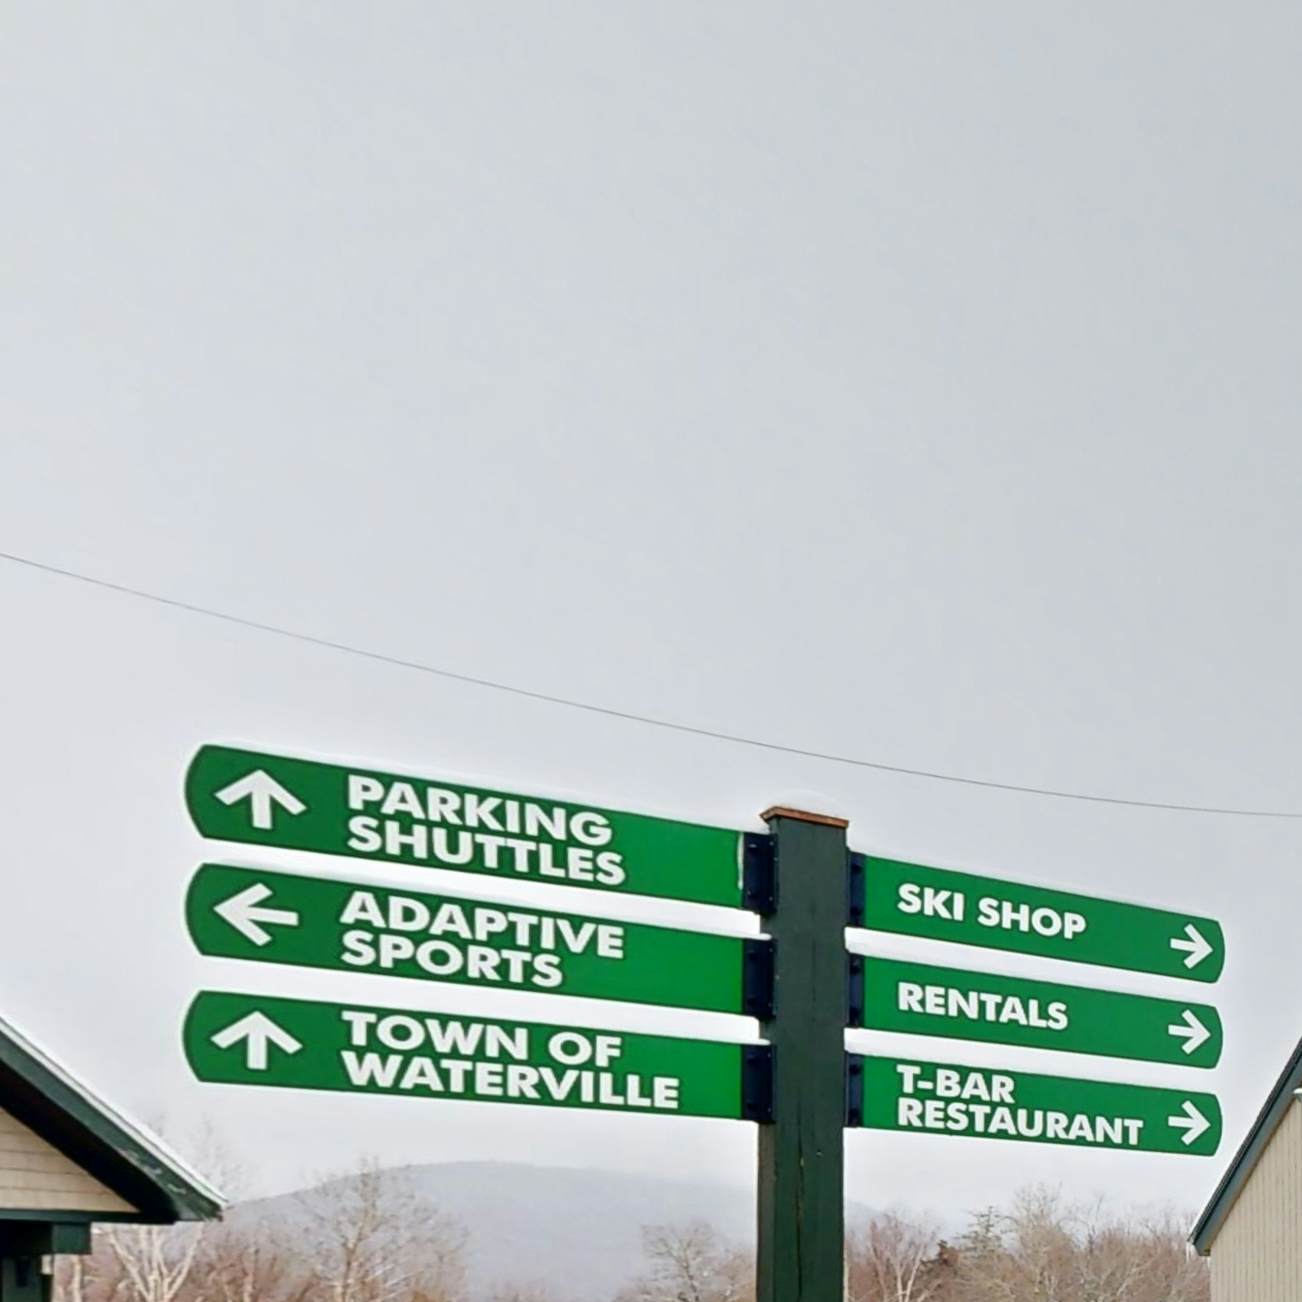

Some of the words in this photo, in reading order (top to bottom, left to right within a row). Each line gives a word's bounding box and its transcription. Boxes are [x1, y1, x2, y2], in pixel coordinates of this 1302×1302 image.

[347, 774, 612, 846] PARKING
[347, 815, 626, 885] SHUTTLES
[339, 891, 624, 959] ADAPTIVE
[897, 883, 964, 921] SKI
[977, 897, 1086, 939] SHOP
[341, 930, 563, 987] SPORTS
[898, 981, 1068, 1030] RENTALS
[341, 1010, 528, 1060] TOWN
[548, 1031, 622, 1068] OF
[340, 1050, 680, 1109] WATERVILLE
[896, 1064, 1015, 1104] T-BAR
[898, 1096, 1144, 1146] RESTAURANT
